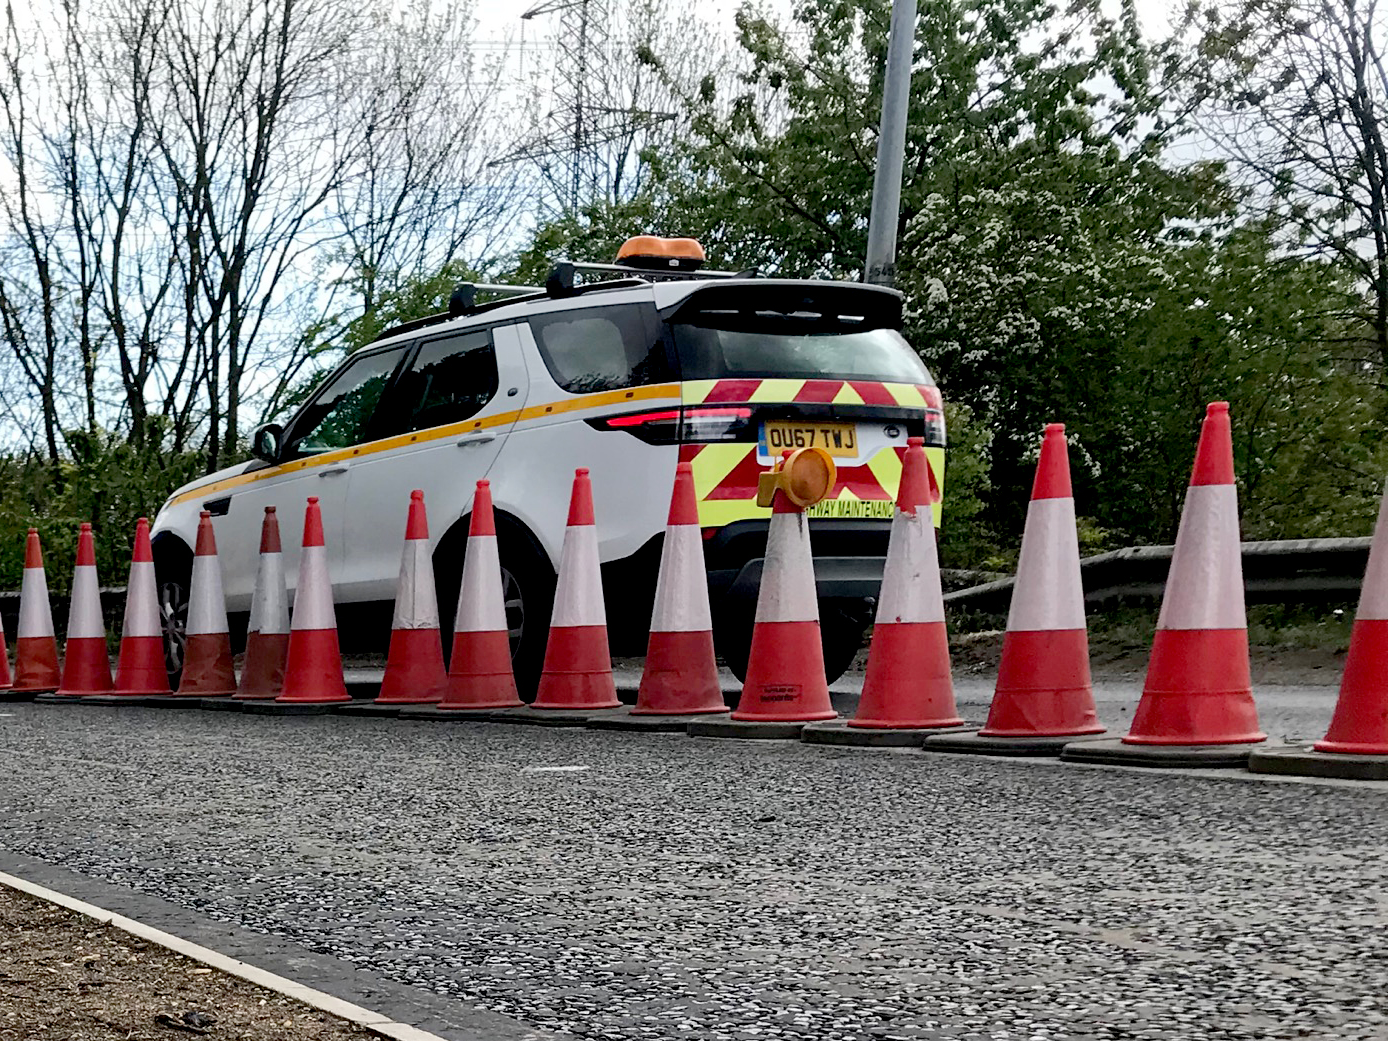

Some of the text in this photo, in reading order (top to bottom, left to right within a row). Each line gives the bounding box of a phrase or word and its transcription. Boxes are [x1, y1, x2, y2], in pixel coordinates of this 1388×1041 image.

[770, 428, 855, 449] OU67 TWJ
[838, 500, 895, 518] MAINTENANC
